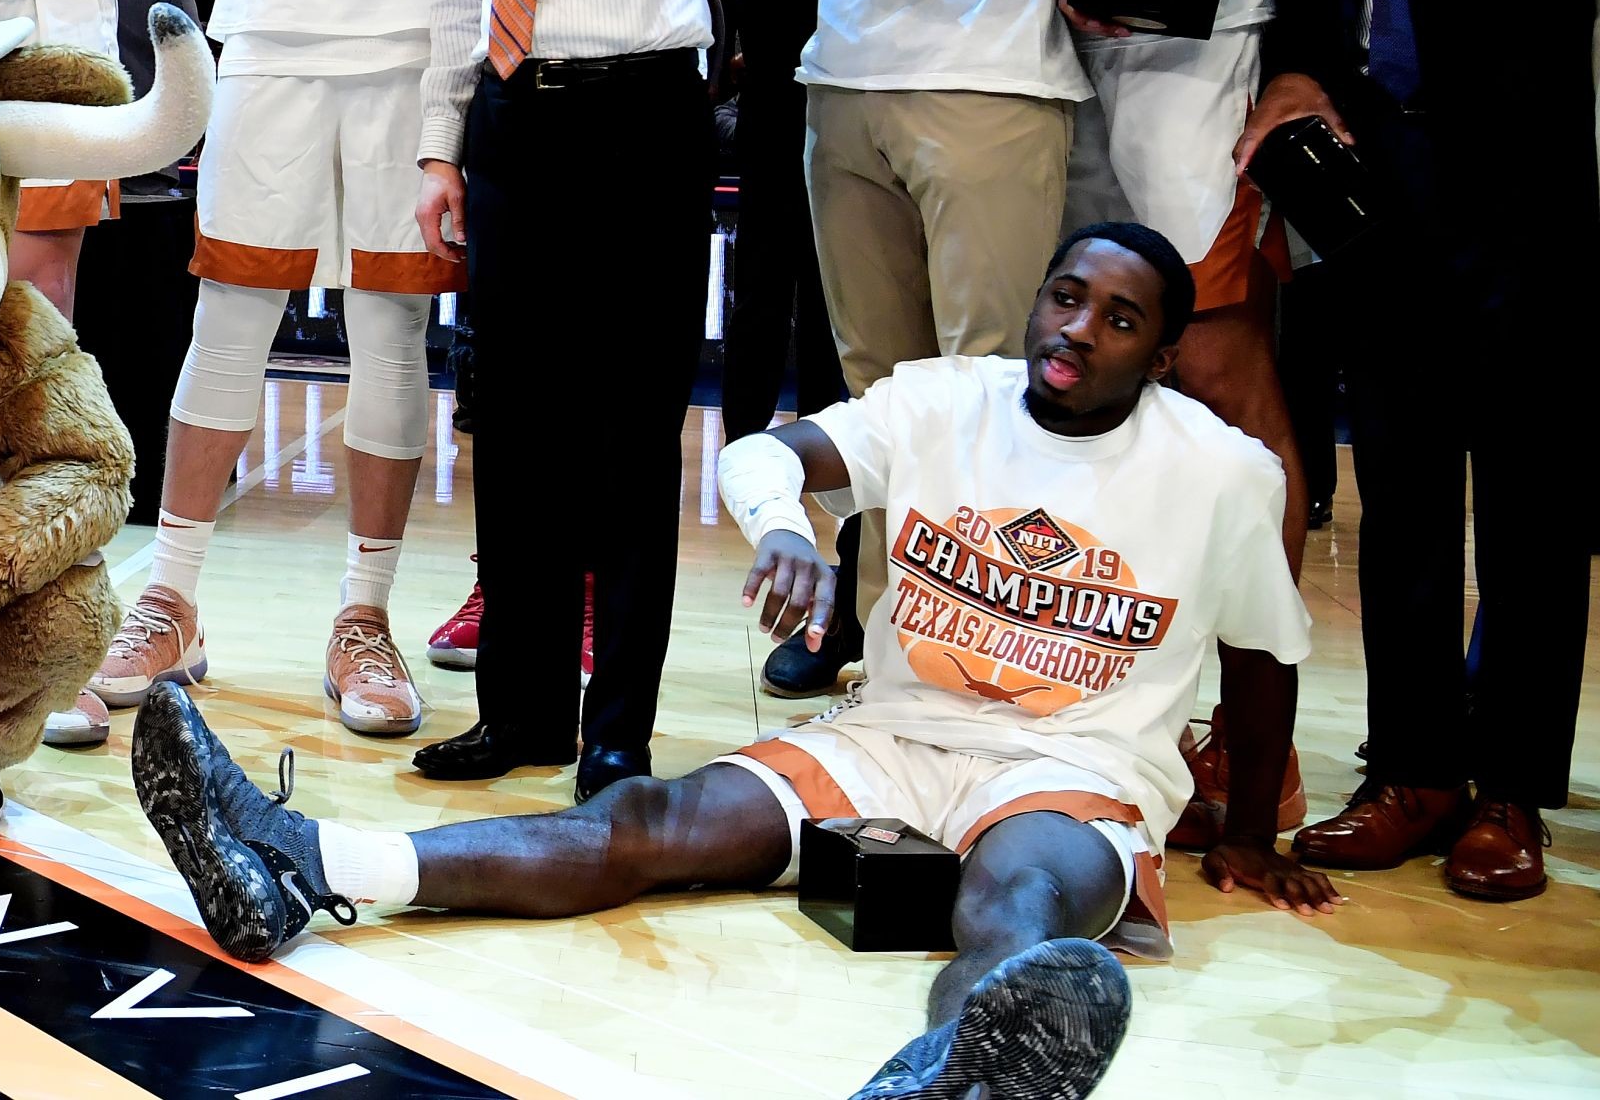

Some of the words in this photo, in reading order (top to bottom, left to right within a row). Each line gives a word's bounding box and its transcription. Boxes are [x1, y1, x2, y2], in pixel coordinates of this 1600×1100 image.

[904, 519, 1163, 642] CHAMPIONS
[954, 505, 992, 547] 20
[1017, 529, 1063, 552] NIT
[1081, 547, 1121, 580] 19
[890, 577, 981, 652] TEXAS
[976, 622, 1135, 692] LONGHORNS
